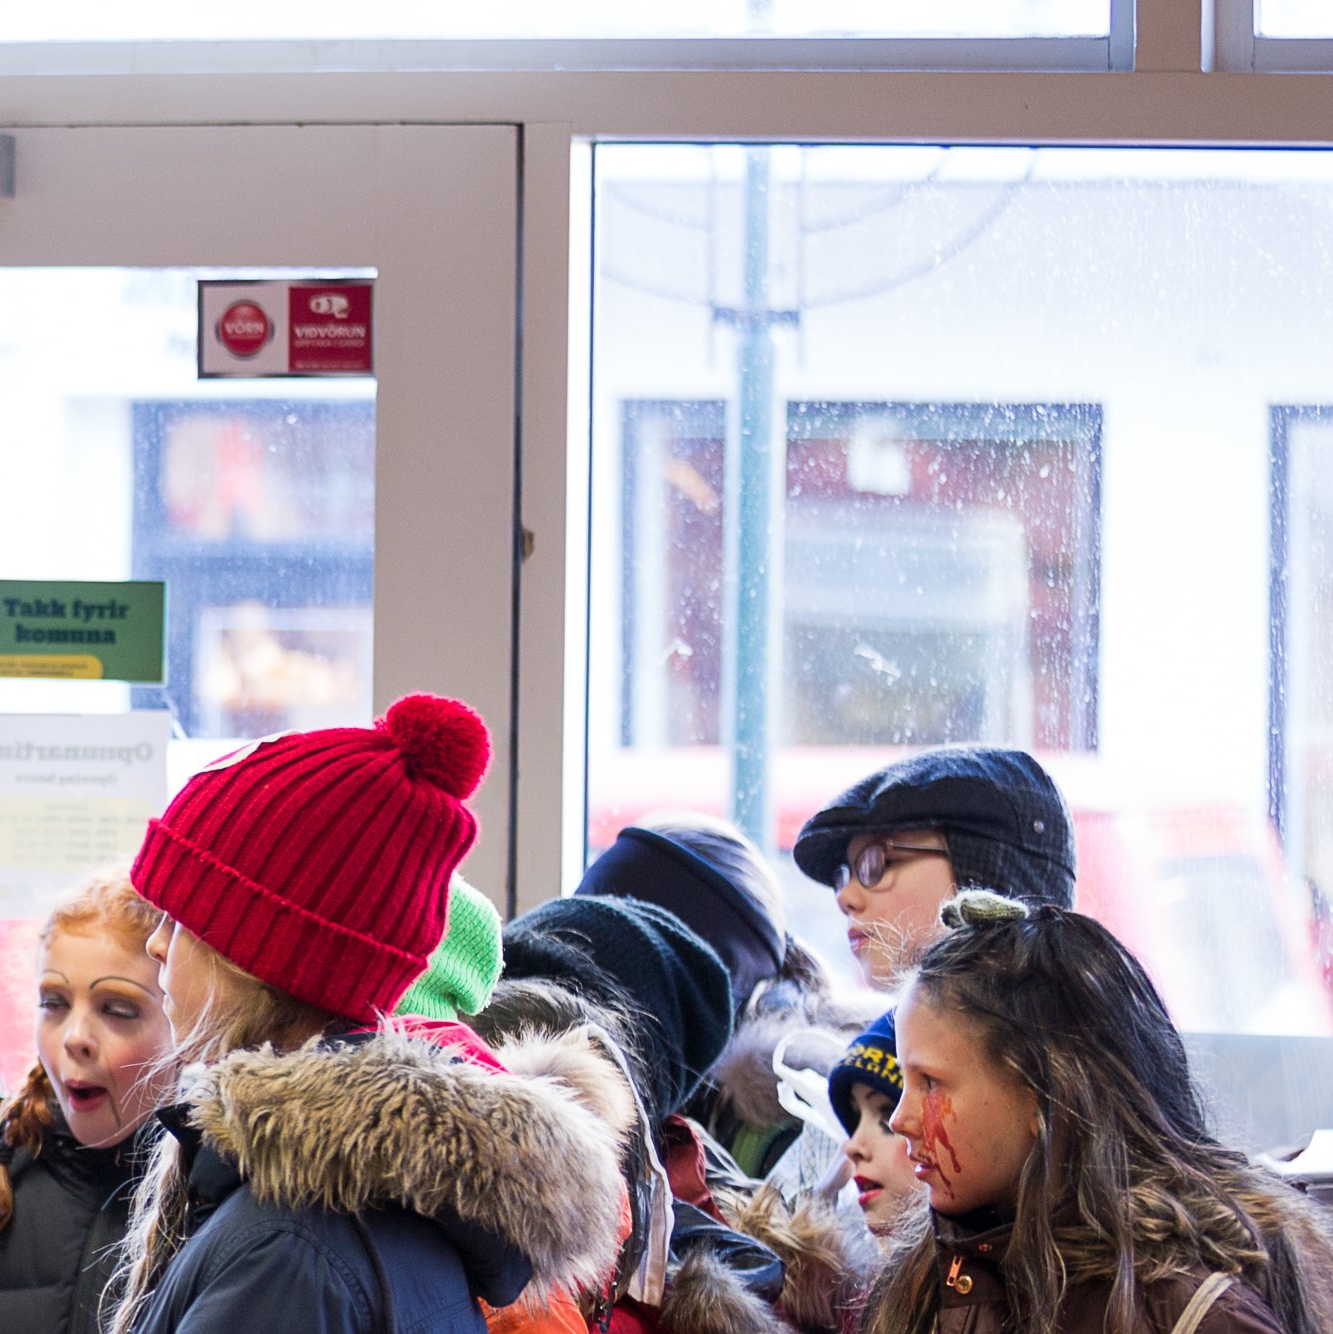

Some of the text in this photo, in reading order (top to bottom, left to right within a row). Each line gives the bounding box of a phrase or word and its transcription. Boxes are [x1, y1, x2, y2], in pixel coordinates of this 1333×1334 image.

[3, 598, 130, 622] Takk fyrir
[15, 624, 116, 644] komuna
